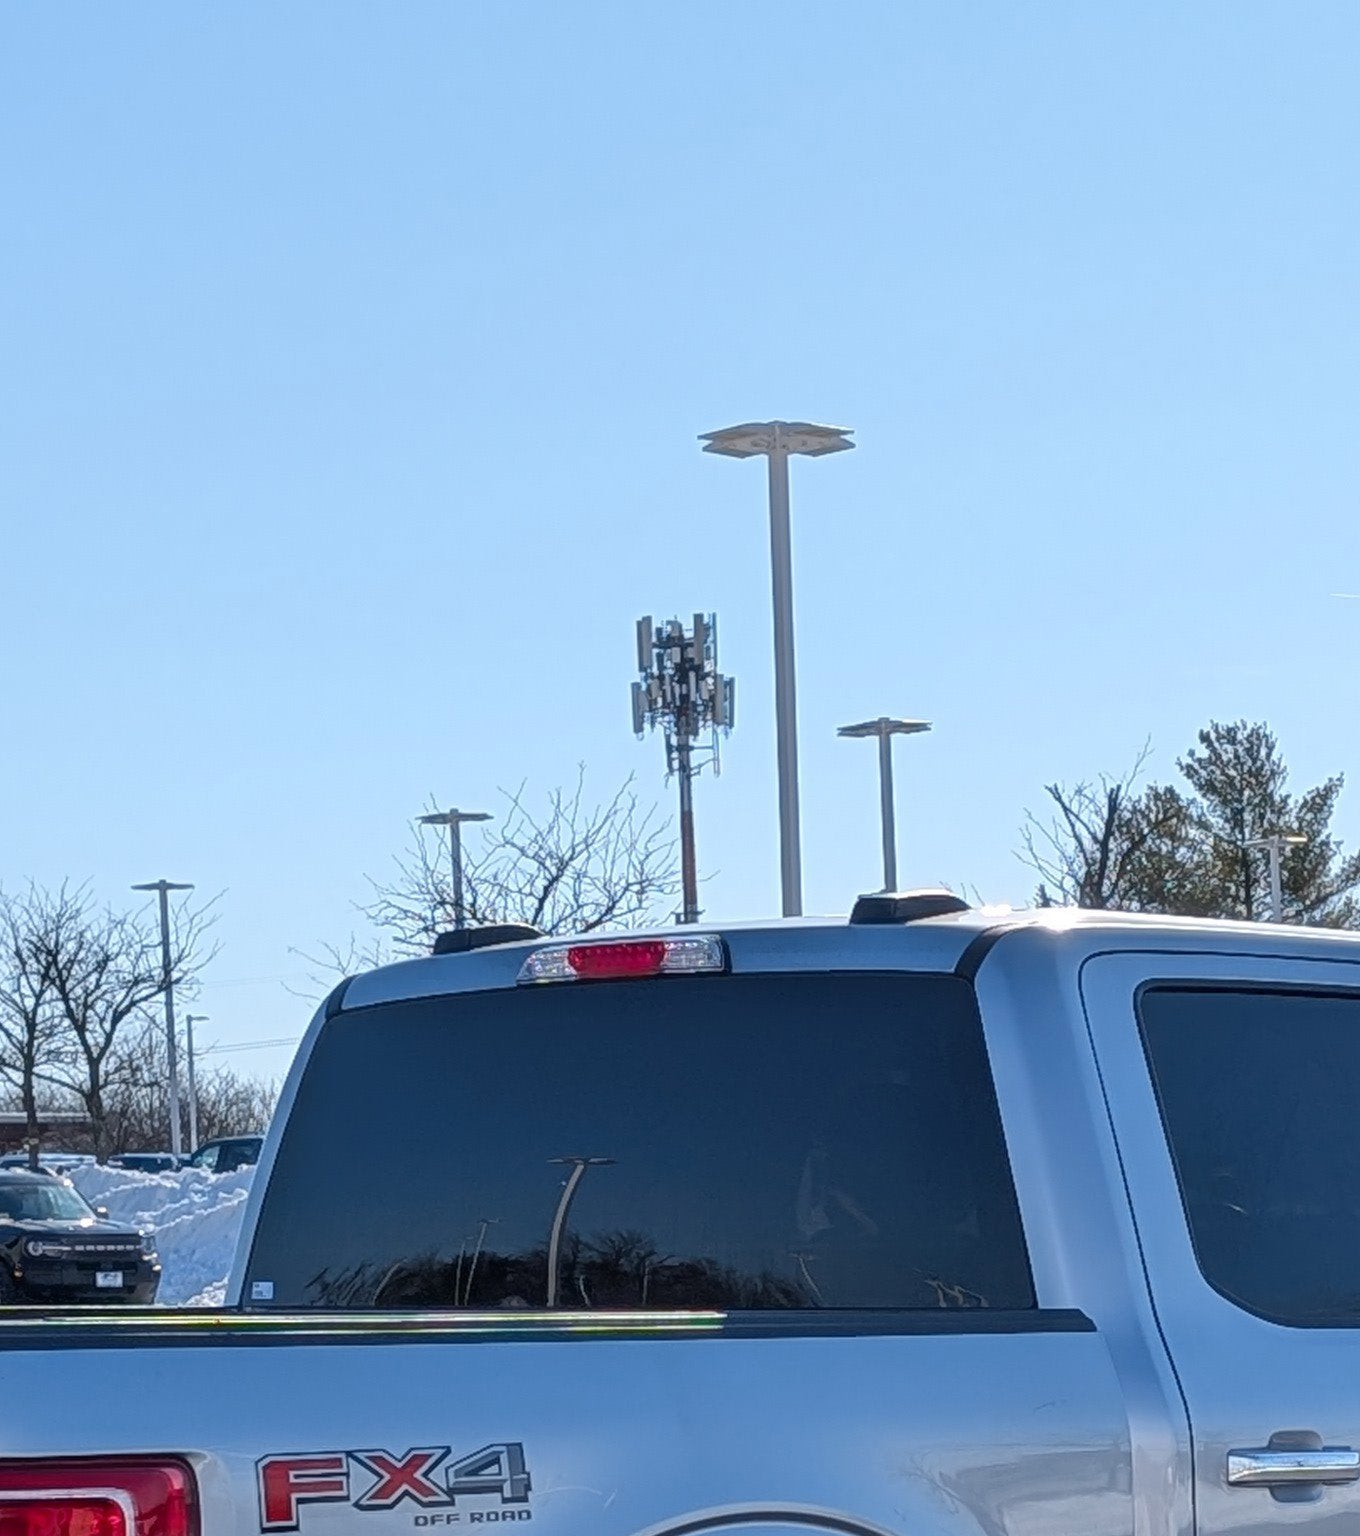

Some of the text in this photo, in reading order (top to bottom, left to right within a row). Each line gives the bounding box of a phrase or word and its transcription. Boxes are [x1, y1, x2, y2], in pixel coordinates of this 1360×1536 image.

[255, 1442, 532, 1534] FX4
[414, 1509, 533, 1527] OFF ROAD
